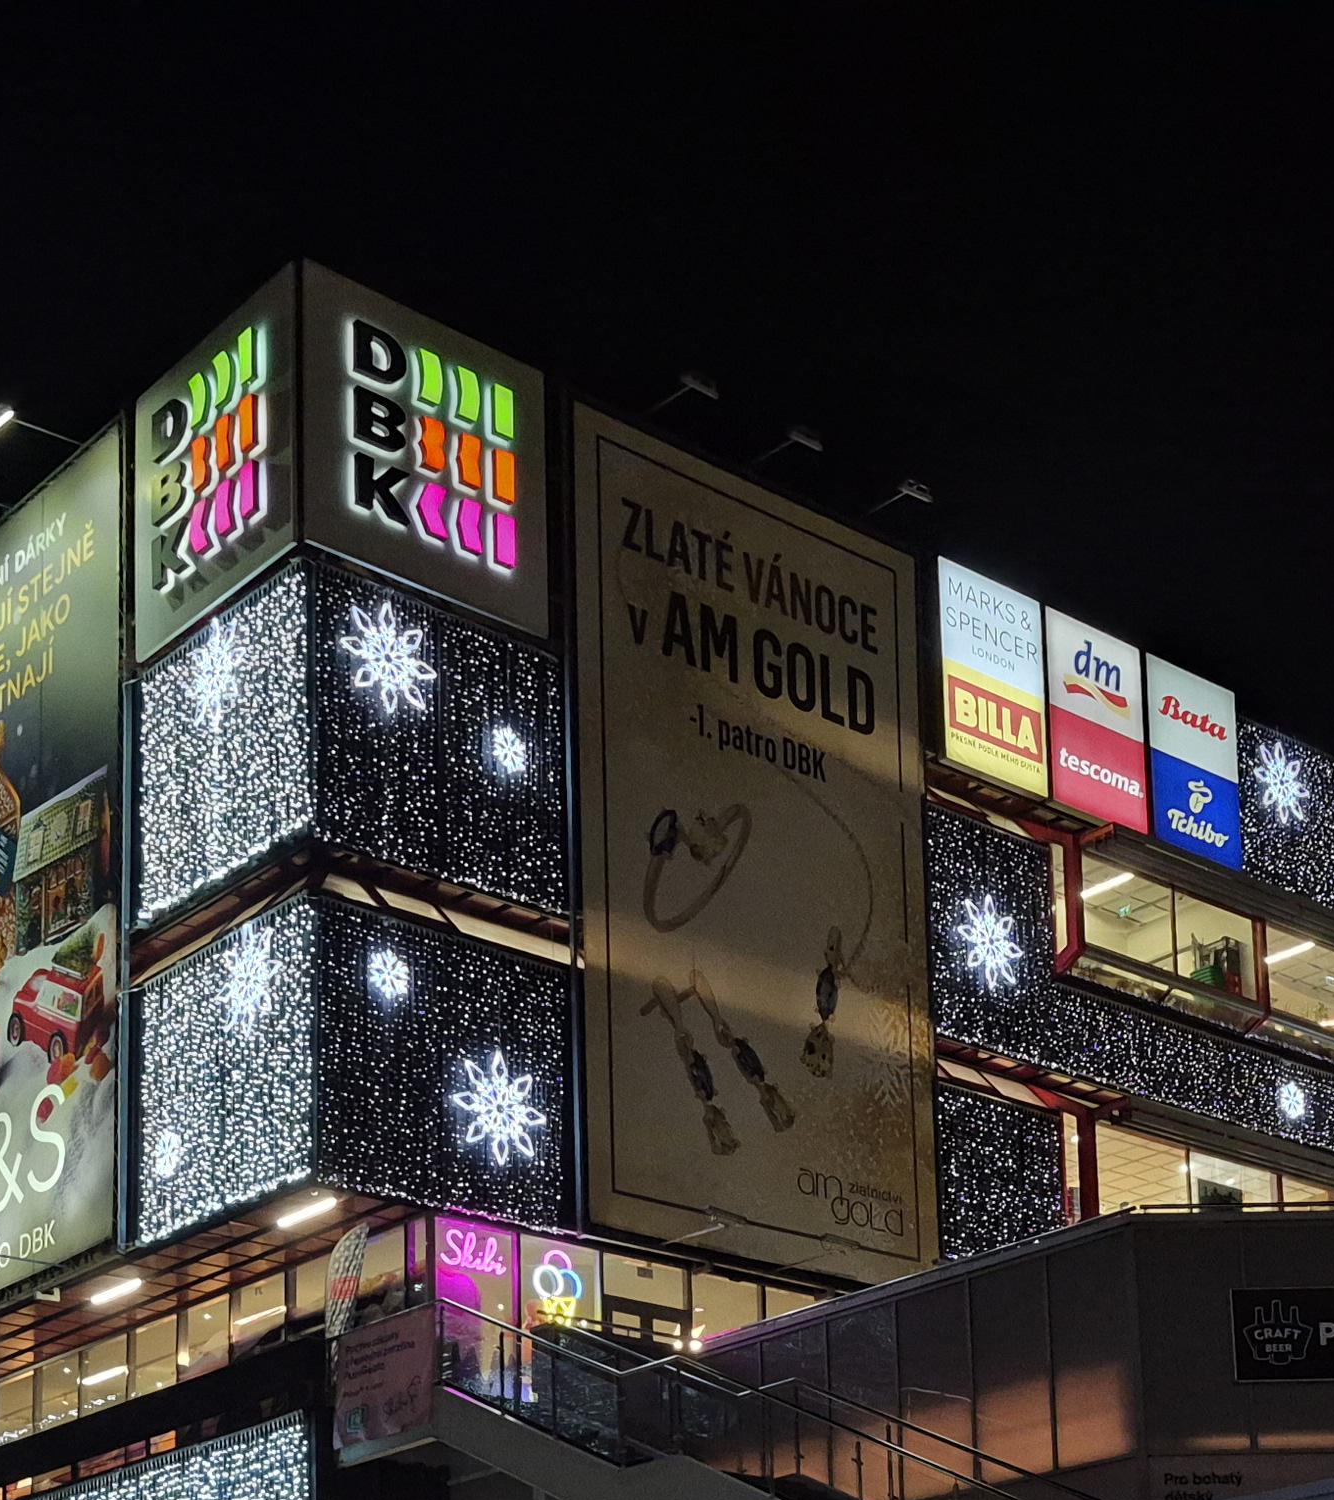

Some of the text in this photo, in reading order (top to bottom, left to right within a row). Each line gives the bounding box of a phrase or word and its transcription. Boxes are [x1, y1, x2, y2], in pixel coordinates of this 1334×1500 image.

[14, 512, 67, 574] DÁRKY
[18, 519, 95, 615] STEJNĚ
[621, 497, 879, 655] ZLATÉ VÁNOCE
[948, 576, 1033, 632] MARKS &
[15, 593, 71, 657] JAKO
[946, 606, 1039, 665] SPENCER
[662, 591, 739, 684] AM
[753, 628, 875, 736] GOLD
[971, 645, 1015, 672] LONDON
[1074, 639, 1121, 692] dm
[954, 686, 1039, 755] BILLA
[718, 719, 777, 764] patro
[783, 737, 826, 783] DBK
[1167, 808, 1229, 848] Tchibo
[19, 1220, 56, 1259] DBK
[440, 1228, 507, 1276] Skibi
[1253, 1327, 1303, 1341] CRAFT
[1265, 1343, 1292, 1352] BEER
[1164, 1473, 1188, 1485] Pro
